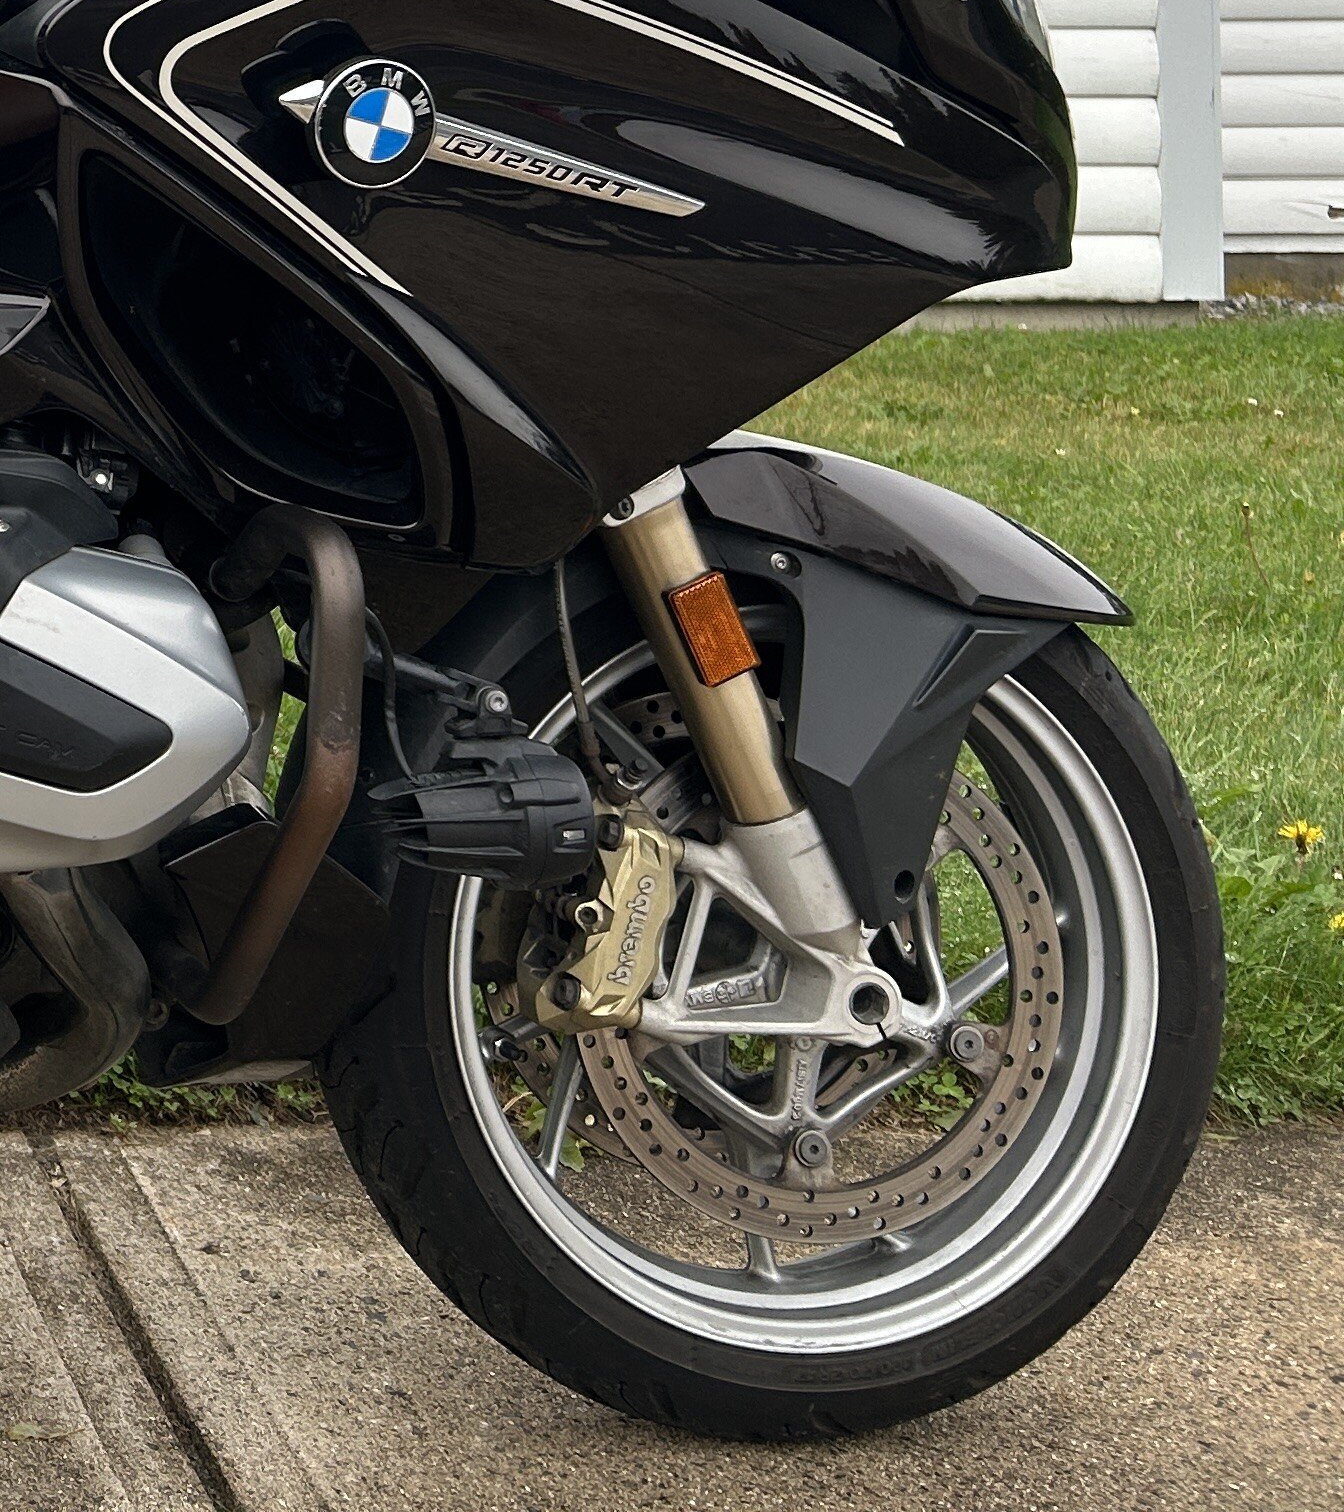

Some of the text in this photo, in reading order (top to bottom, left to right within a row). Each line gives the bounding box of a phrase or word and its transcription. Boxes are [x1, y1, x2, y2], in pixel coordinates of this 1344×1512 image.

[342, 67, 431, 118] BMW
[489, 146, 573, 181] 1250
[606, 874, 657, 986] brembo
